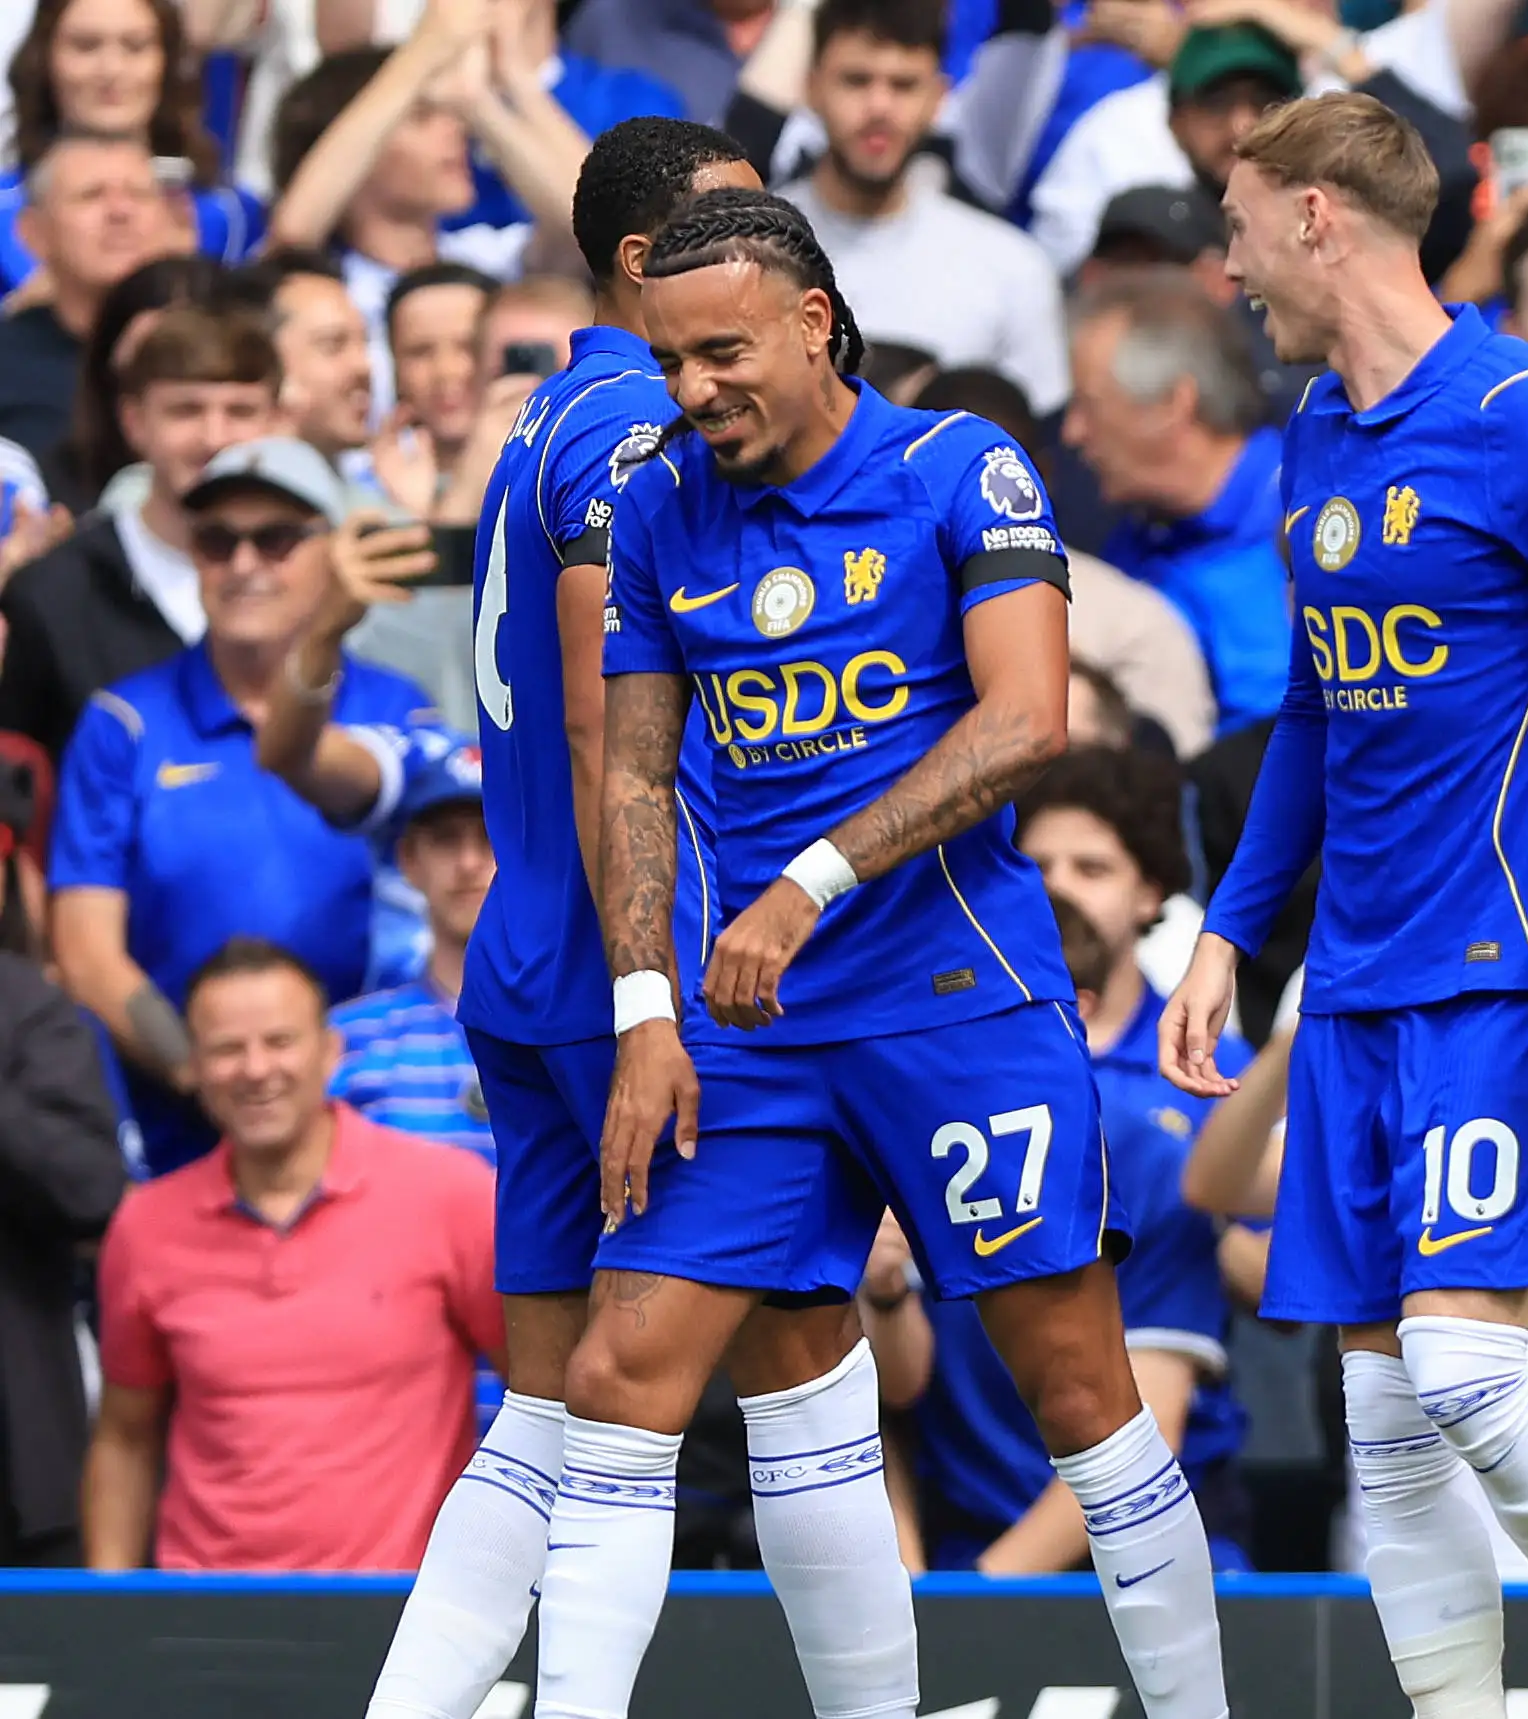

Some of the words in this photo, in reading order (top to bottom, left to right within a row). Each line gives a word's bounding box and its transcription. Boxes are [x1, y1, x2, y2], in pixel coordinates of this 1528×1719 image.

[982, 527, 1008, 544] No
[1009, 526, 1051, 540] room
[694, 650, 909, 745] USDC
[1336, 685, 1409, 711] CIRCLE
[749, 747, 771, 764] BY
[774, 727, 869, 762] CIRCLE
[931, 1104, 1052, 1224] 27
[1421, 1117, 1519, 1224] 10
[752, 1466, 808, 1484] CFC
